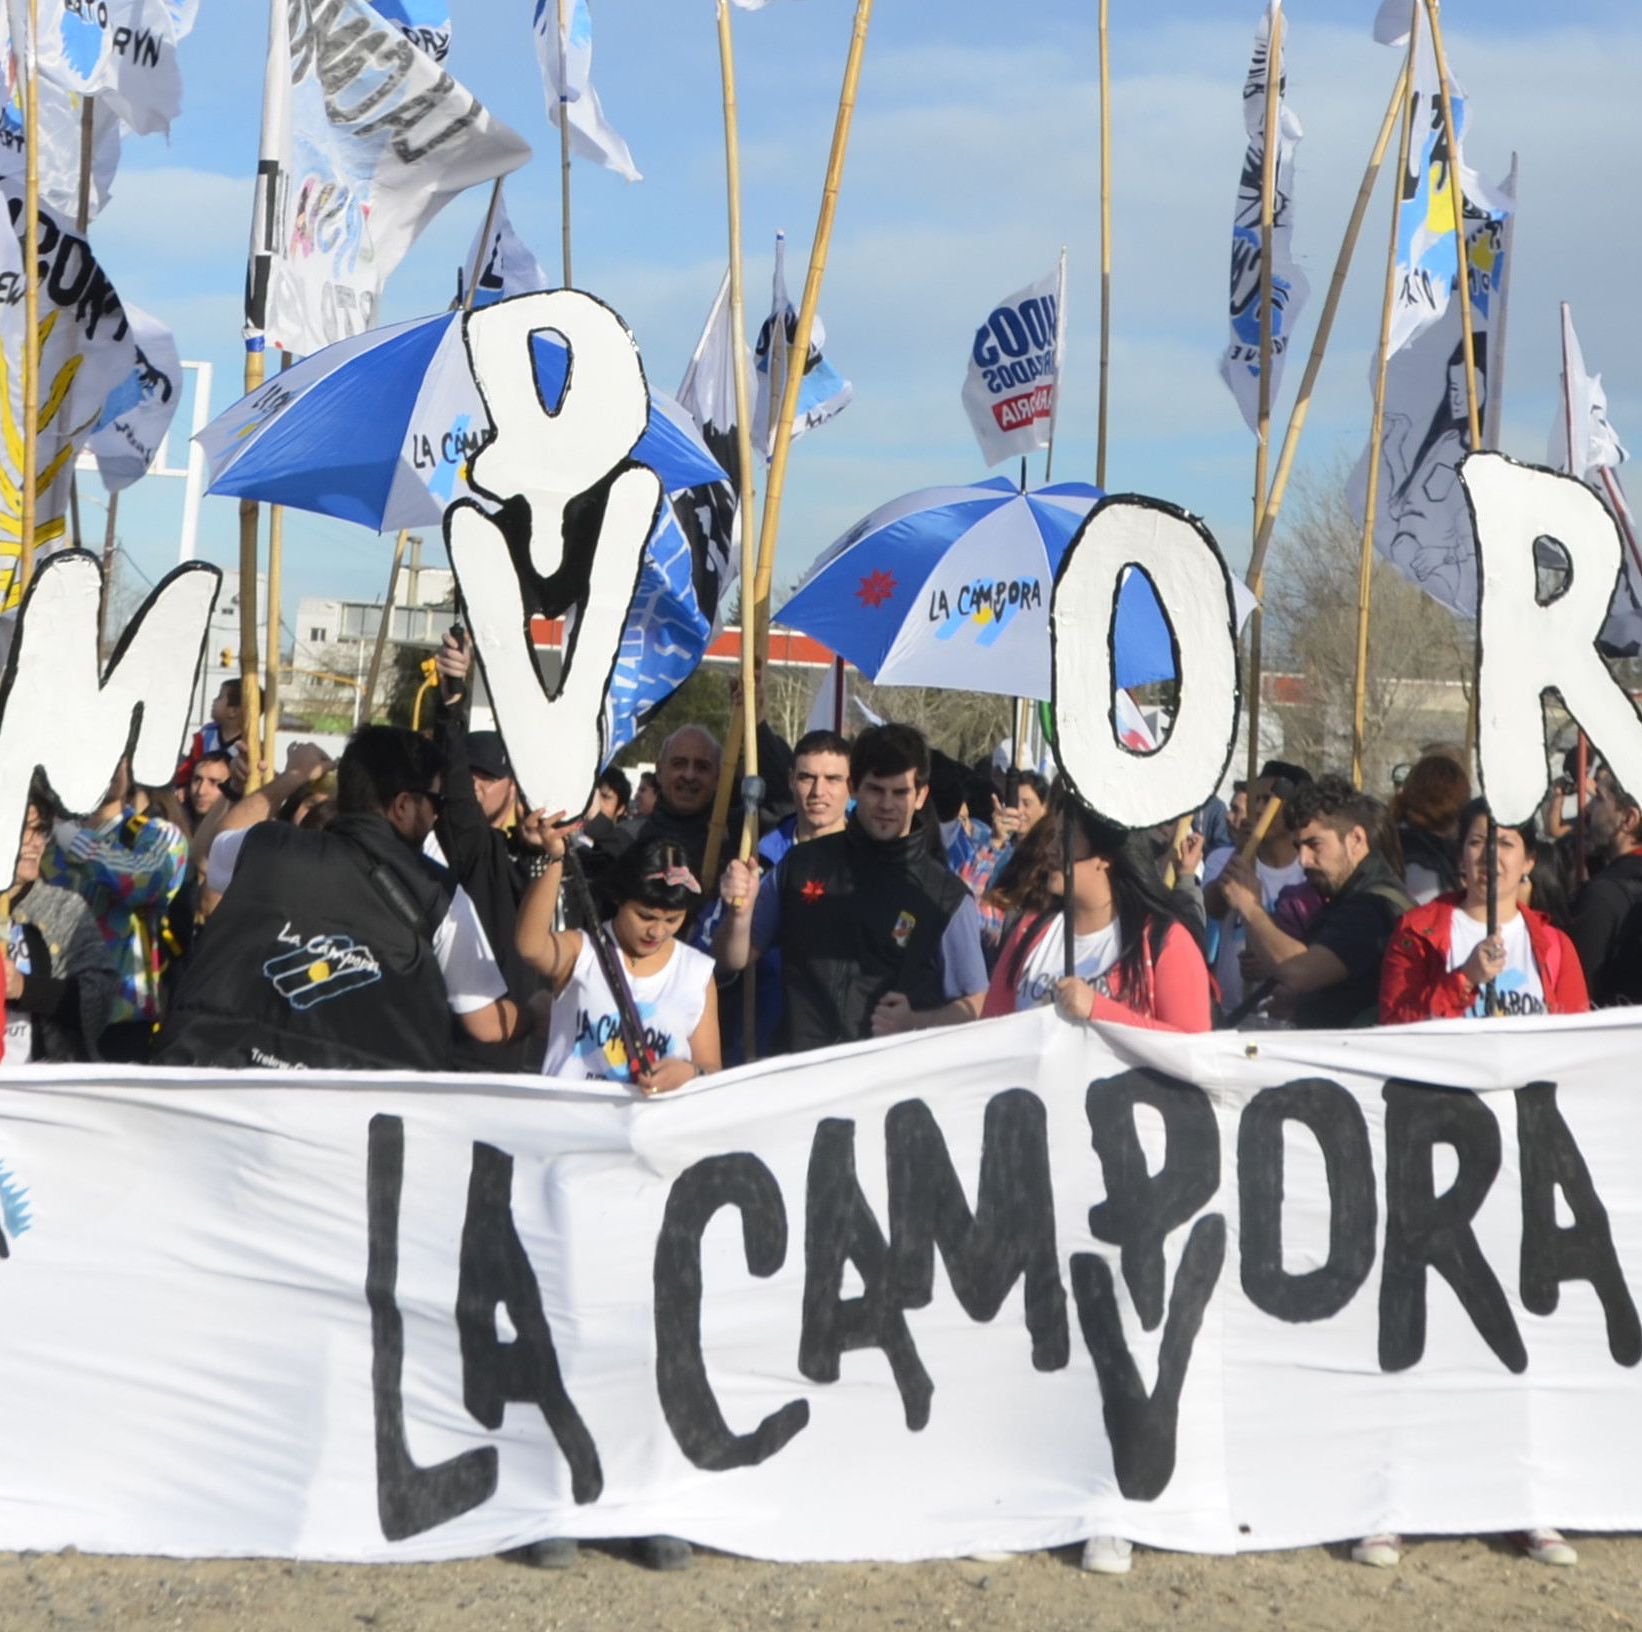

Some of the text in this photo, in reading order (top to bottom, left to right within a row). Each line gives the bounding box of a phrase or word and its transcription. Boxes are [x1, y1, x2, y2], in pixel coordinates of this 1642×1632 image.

[413, 433, 437, 469] LA
[929, 590, 951, 622] LA
[575, 1008, 595, 1043] LA
[367, 1111, 604, 1542] LA
